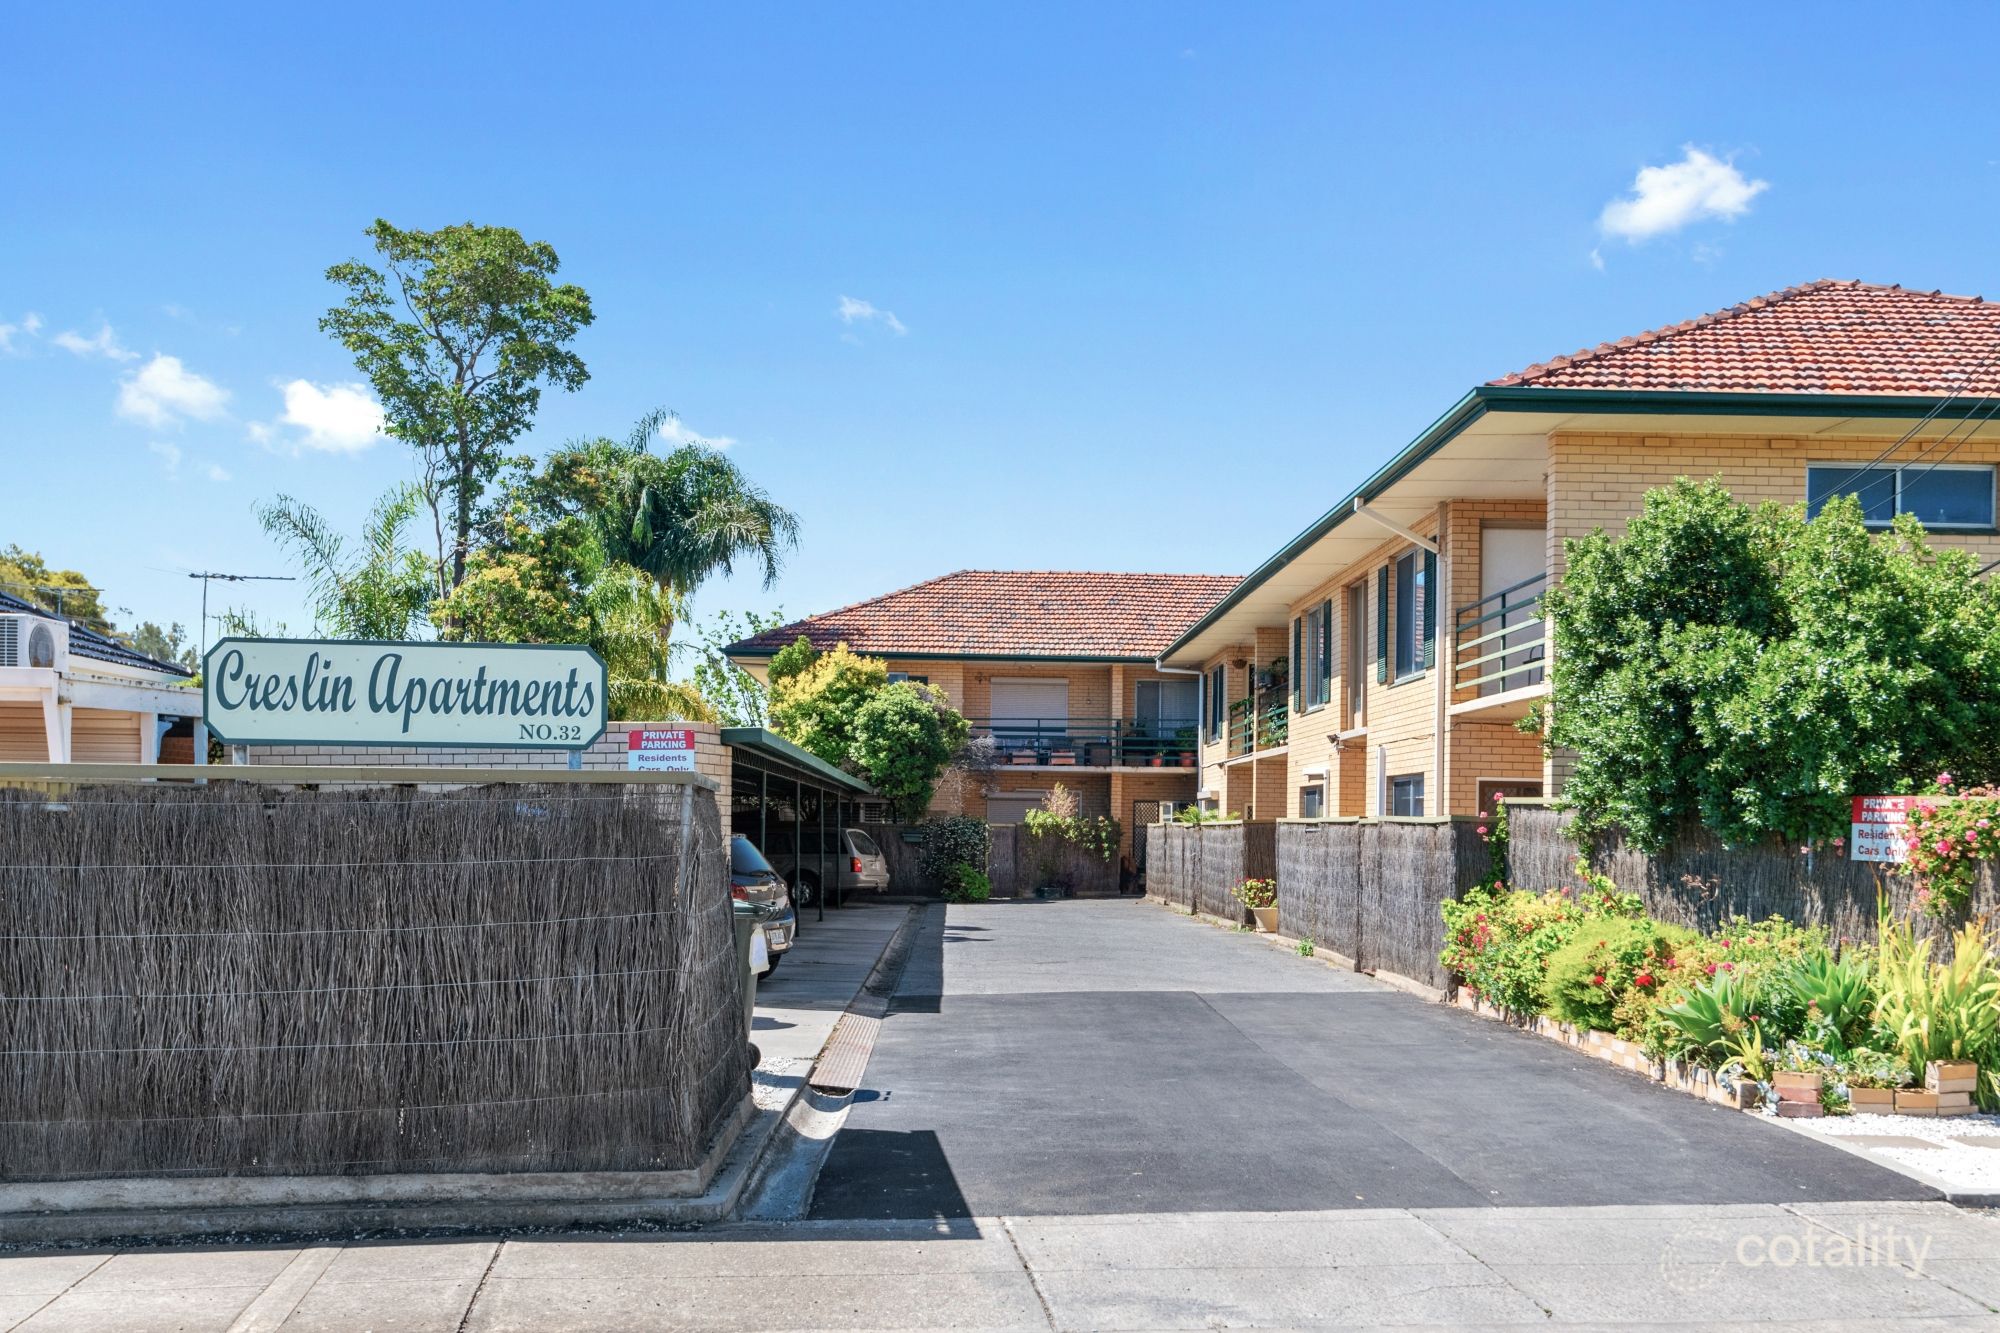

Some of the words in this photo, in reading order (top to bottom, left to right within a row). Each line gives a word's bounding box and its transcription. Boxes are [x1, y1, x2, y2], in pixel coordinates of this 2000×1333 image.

[216, 650, 356, 712] Creslin
[368, 653, 595, 733] Apartments
[519, 724, 581, 740] NO.32
[642, 731, 685, 739] PRIVATE
[641, 741, 686, 749] PARKING
[638, 754, 687, 762] Residents
[1861, 812, 1905, 821] PARKING
[1858, 845, 1880, 855] Cars
